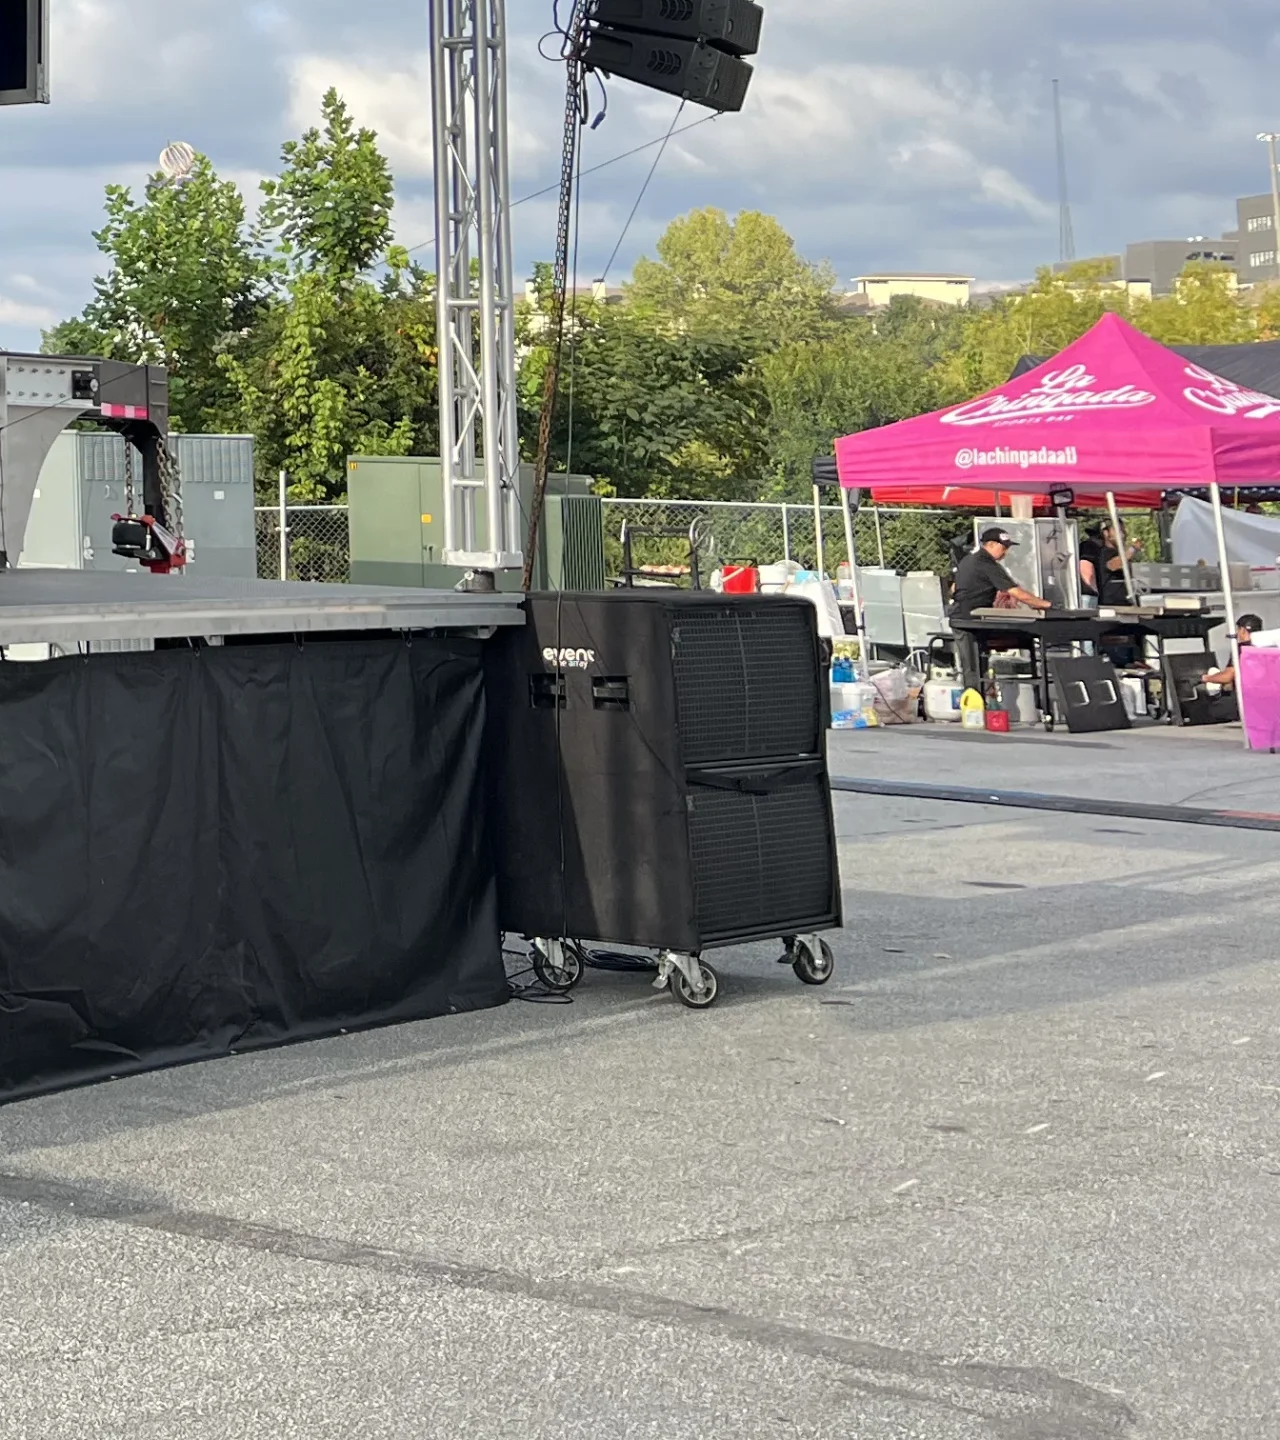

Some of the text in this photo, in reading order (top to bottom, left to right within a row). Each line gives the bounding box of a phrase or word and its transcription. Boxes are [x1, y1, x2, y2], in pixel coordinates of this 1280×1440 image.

[1031, 364, 1098, 394] La
[939, 384, 1156, 425] Chingada
[954, 446, 1077, 469] @lachingadaatl
